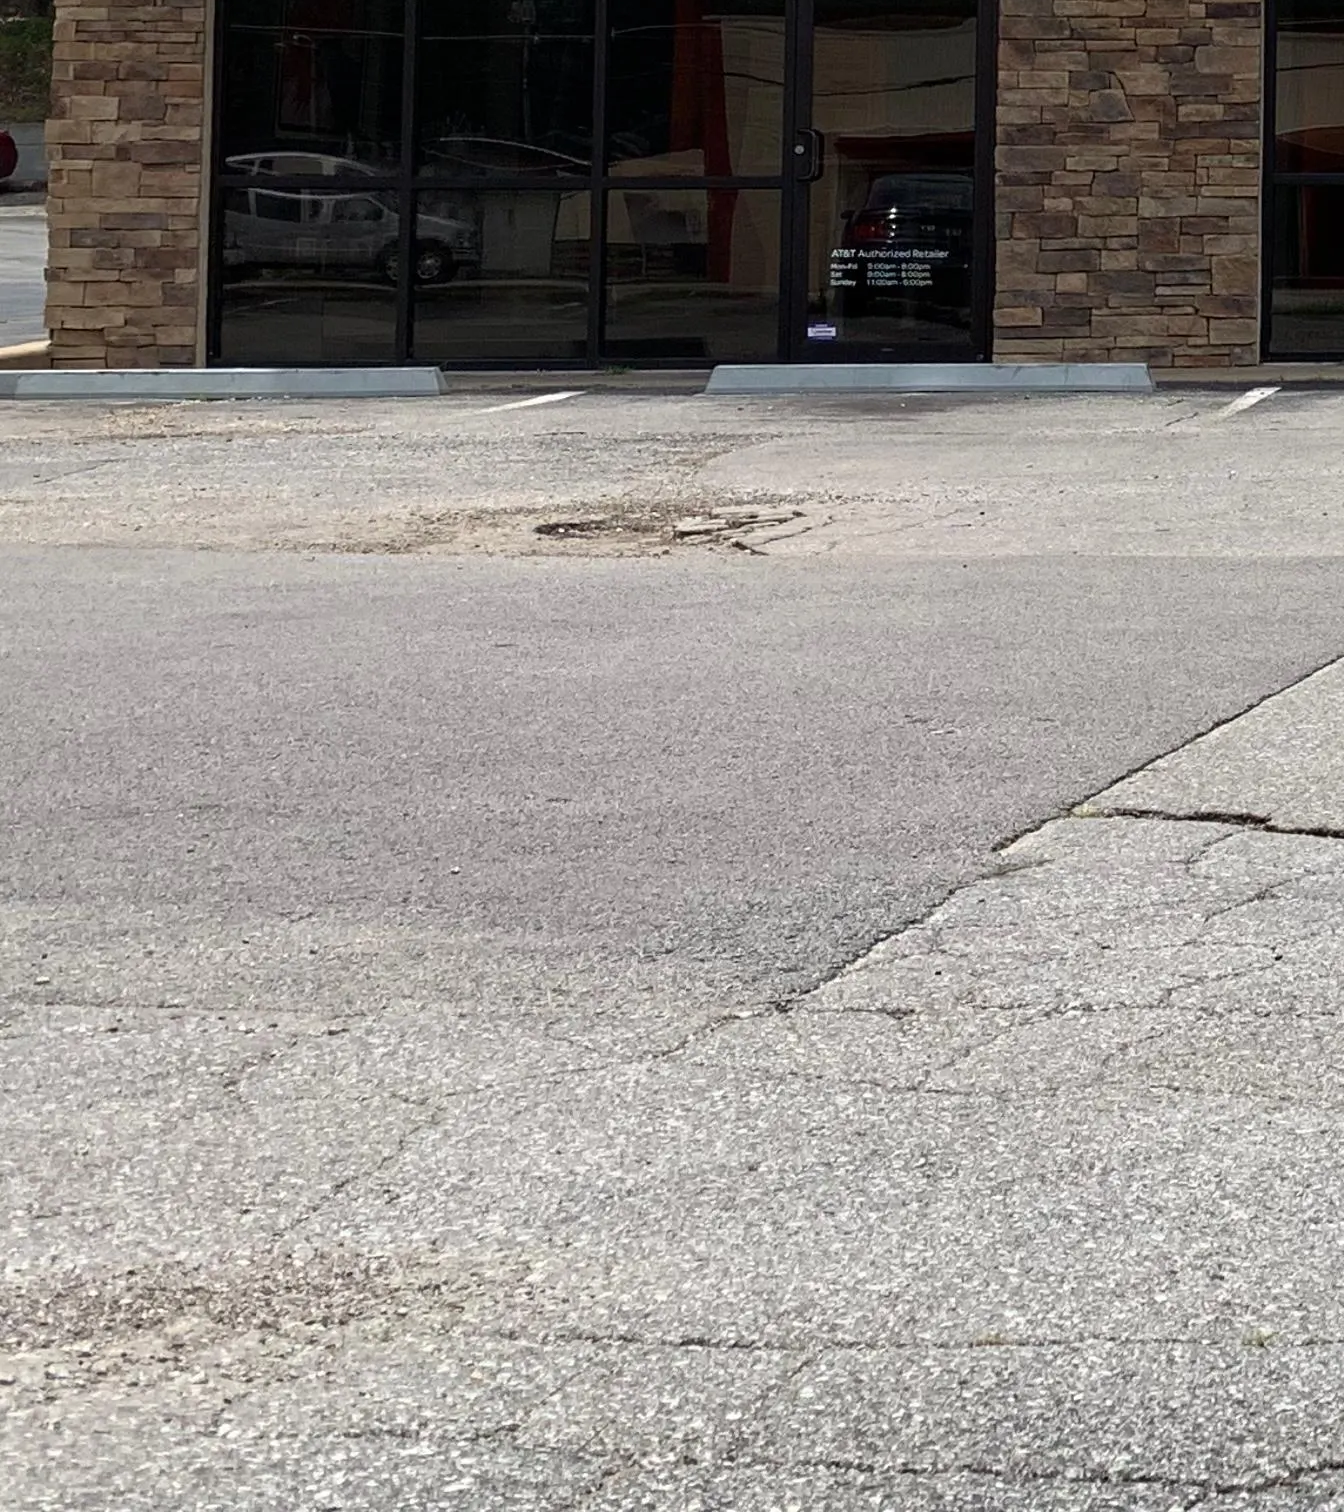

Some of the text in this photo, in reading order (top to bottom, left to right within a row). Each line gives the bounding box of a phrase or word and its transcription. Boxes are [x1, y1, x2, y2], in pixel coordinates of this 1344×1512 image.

[831, 249, 950, 258] AT&T Authorized Retailer
